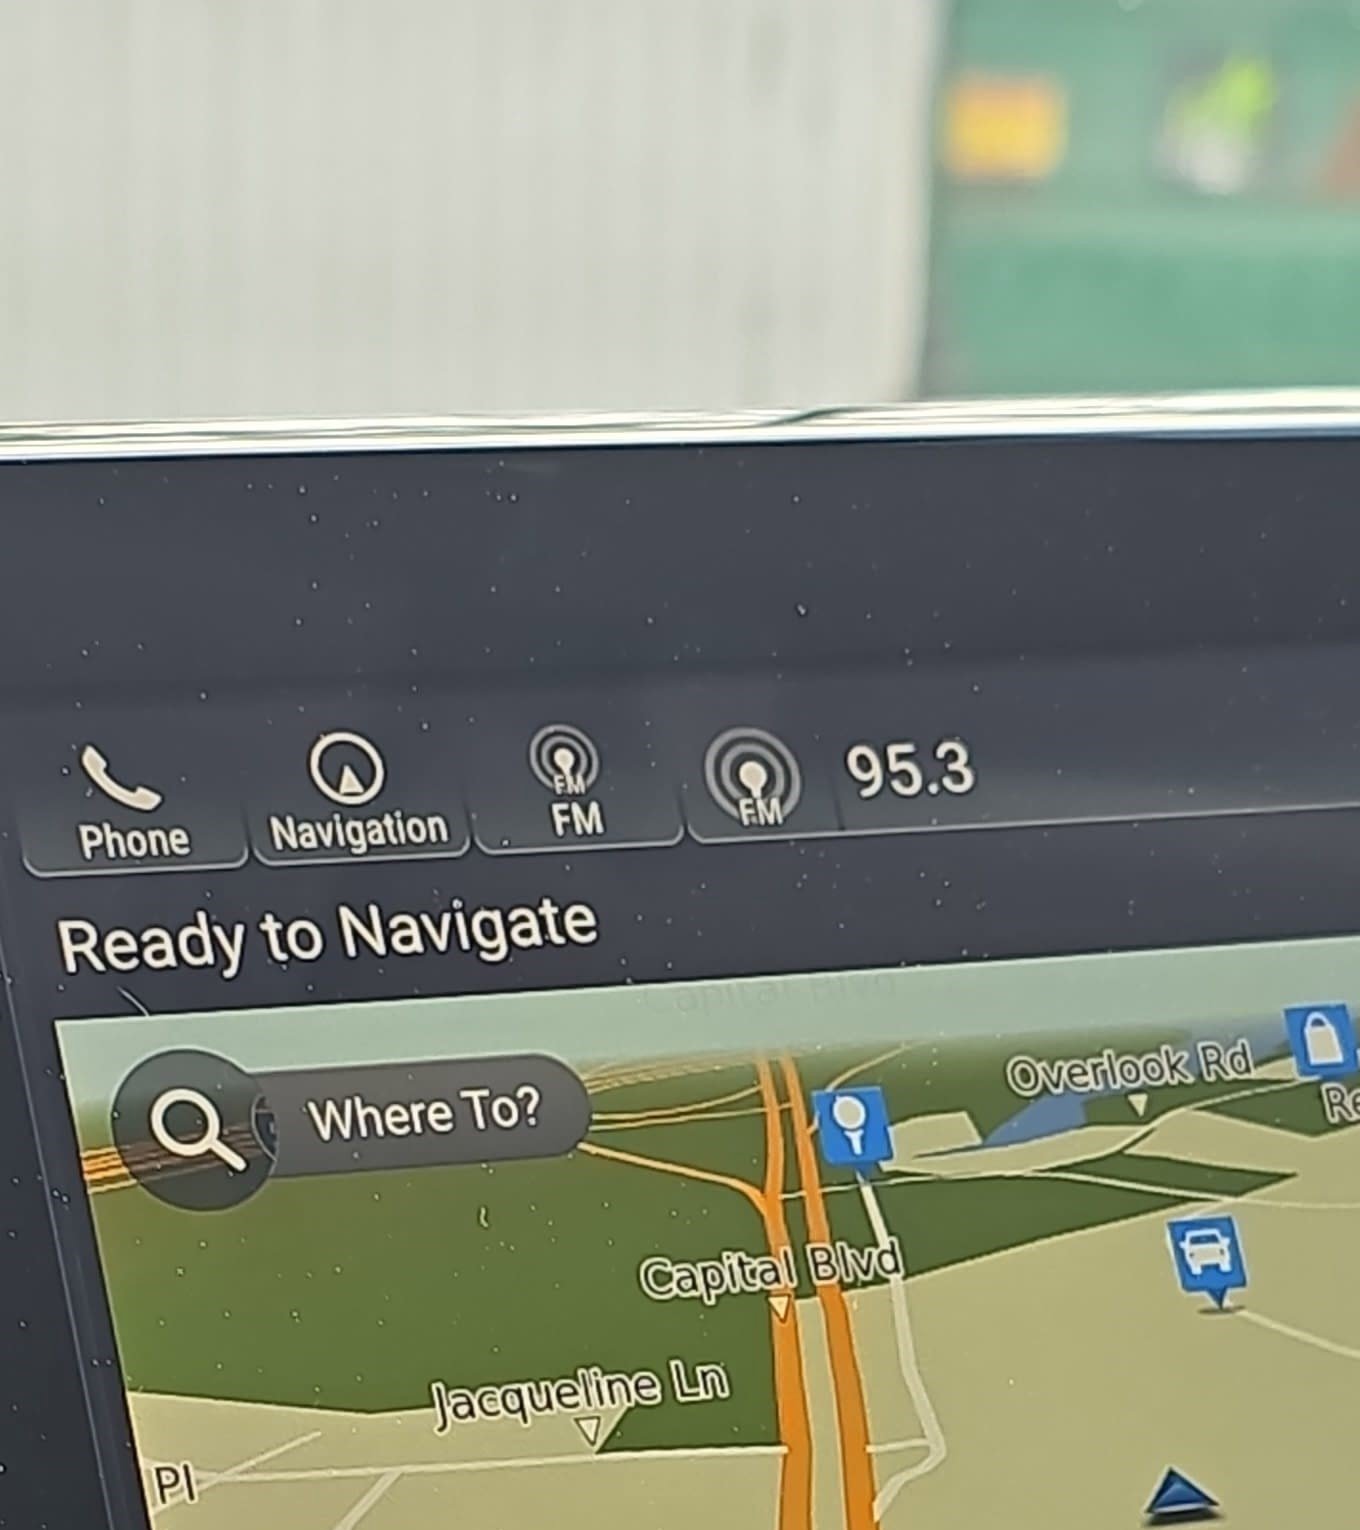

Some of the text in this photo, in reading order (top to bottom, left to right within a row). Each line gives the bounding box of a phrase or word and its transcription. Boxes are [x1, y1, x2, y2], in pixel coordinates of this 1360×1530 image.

[553, 774, 586, 795] FM
[845, 741, 976, 799] 95.3
[270, 810, 449, 856] Navigation
[551, 801, 604, 837] FM
[738, 797, 784, 826] FM
[79, 822, 191, 862] Phone
[57, 897, 599, 978] Ready to Navigate
[1006, 1041, 1255, 1096] Overlook Rd
[308, 1086, 540, 1142] Where To?
[640, 1238, 904, 1305] Capital Blvd
[432, 1360, 730, 1432] Jacqueline Ln
